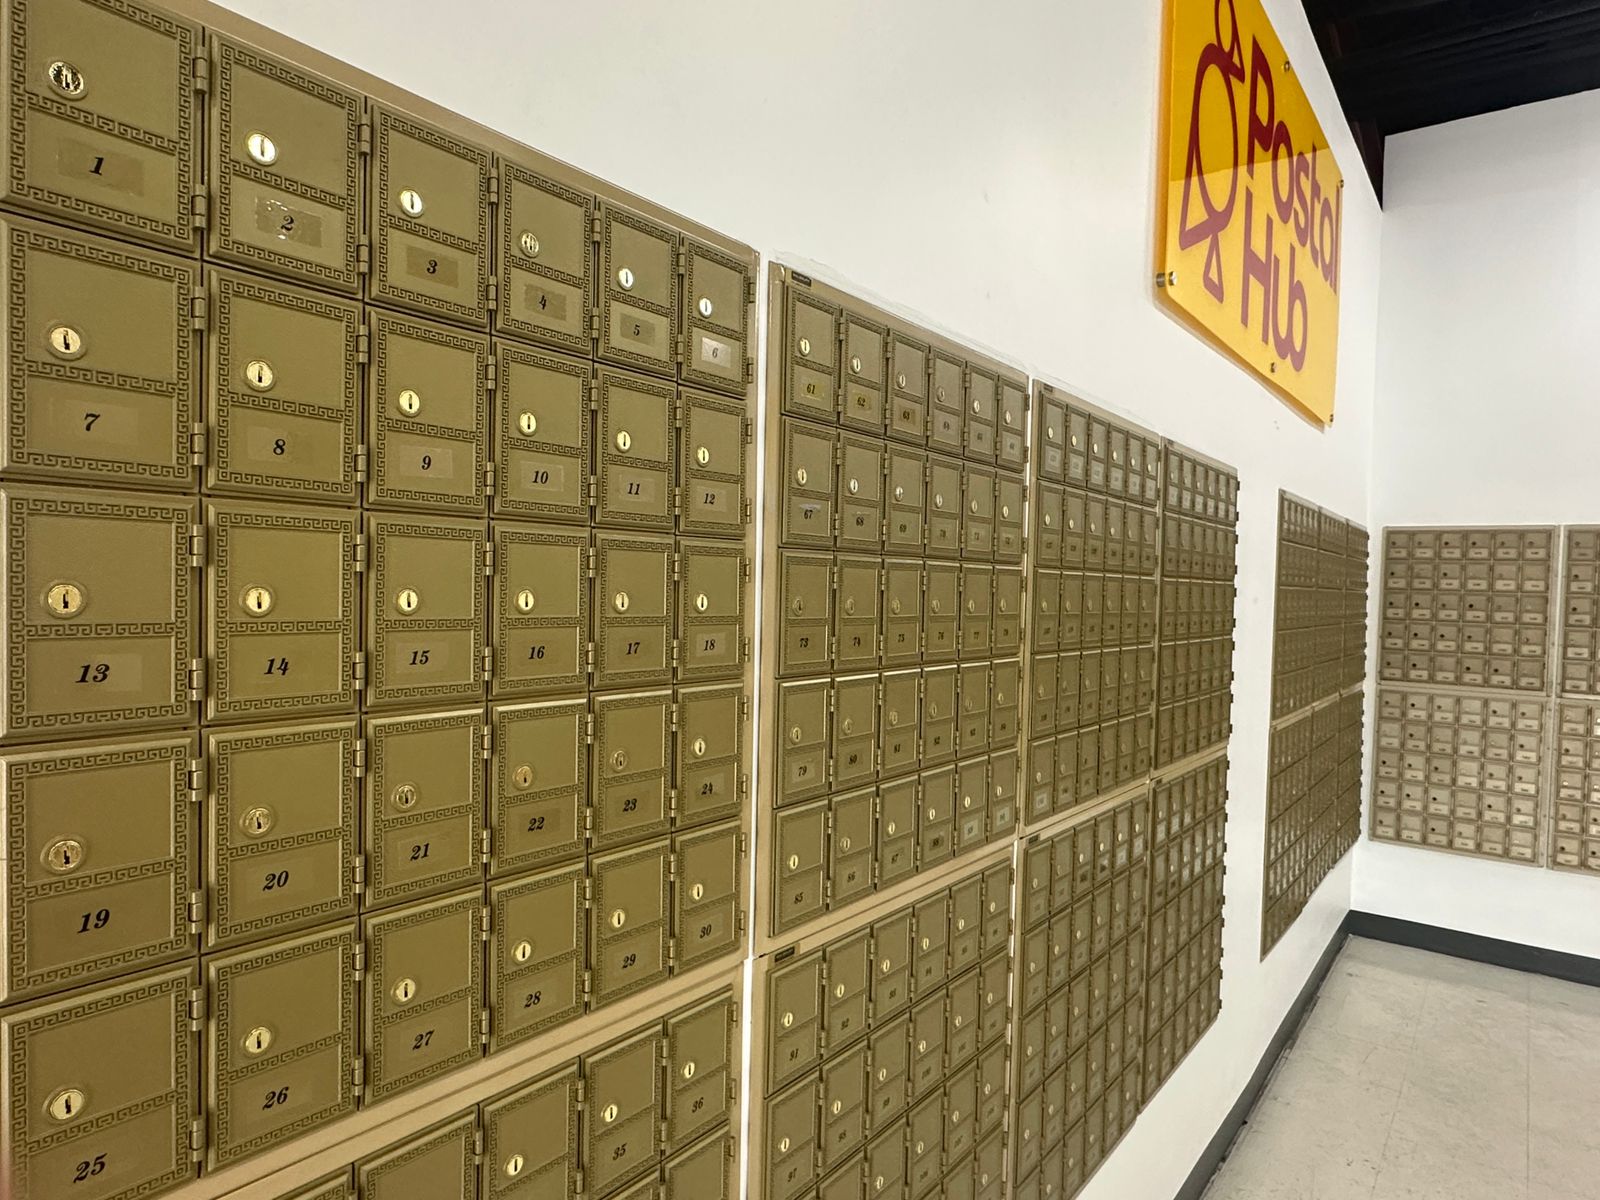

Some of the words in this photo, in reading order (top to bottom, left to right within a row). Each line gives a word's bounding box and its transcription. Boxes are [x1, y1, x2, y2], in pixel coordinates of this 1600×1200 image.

[89, 156, 105, 176] 1
[1247, 34, 1340, 295] Postal
[280, 215, 295, 232] 2
[426, 259, 438, 275] 3
[1240, 186, 1308, 372] Hub
[538, 294, 547, 311] 4
[634, 324, 641, 337] 5
[711, 347, 719, 359] 6
[84, 412, 101, 432] 7
[272, 438, 286, 456] 8
[421, 455, 432, 471] 9
[532, 470, 549, 485] 10
[627, 482, 641, 496] 11
[703, 492, 716, 505] 12
[528, 645, 546, 660] 16
[626, 641, 641, 656] 17
[703, 638, 716, 652] 18
[409, 649, 430, 666] 15
[75, 663, 110, 684] 13
[263, 657, 289, 676] 14
[701, 782, 713, 796] 24
[622, 798, 638, 813] 23
[527, 816, 545, 833] 22
[409, 842, 430, 862] 21
[262, 870, 290, 892] 20
[77, 908, 110, 934] 19
[699, 923, 712, 939] 30
[621, 953, 637, 969] 29
[523, 990, 542, 1009] 28
[412, 1029, 435, 1051] 27
[262, 1086, 290, 1111] 26
[691, 1096, 704, 1114] 36
[612, 1142, 628, 1161] 35
[72, 1152, 108, 1184] 25
